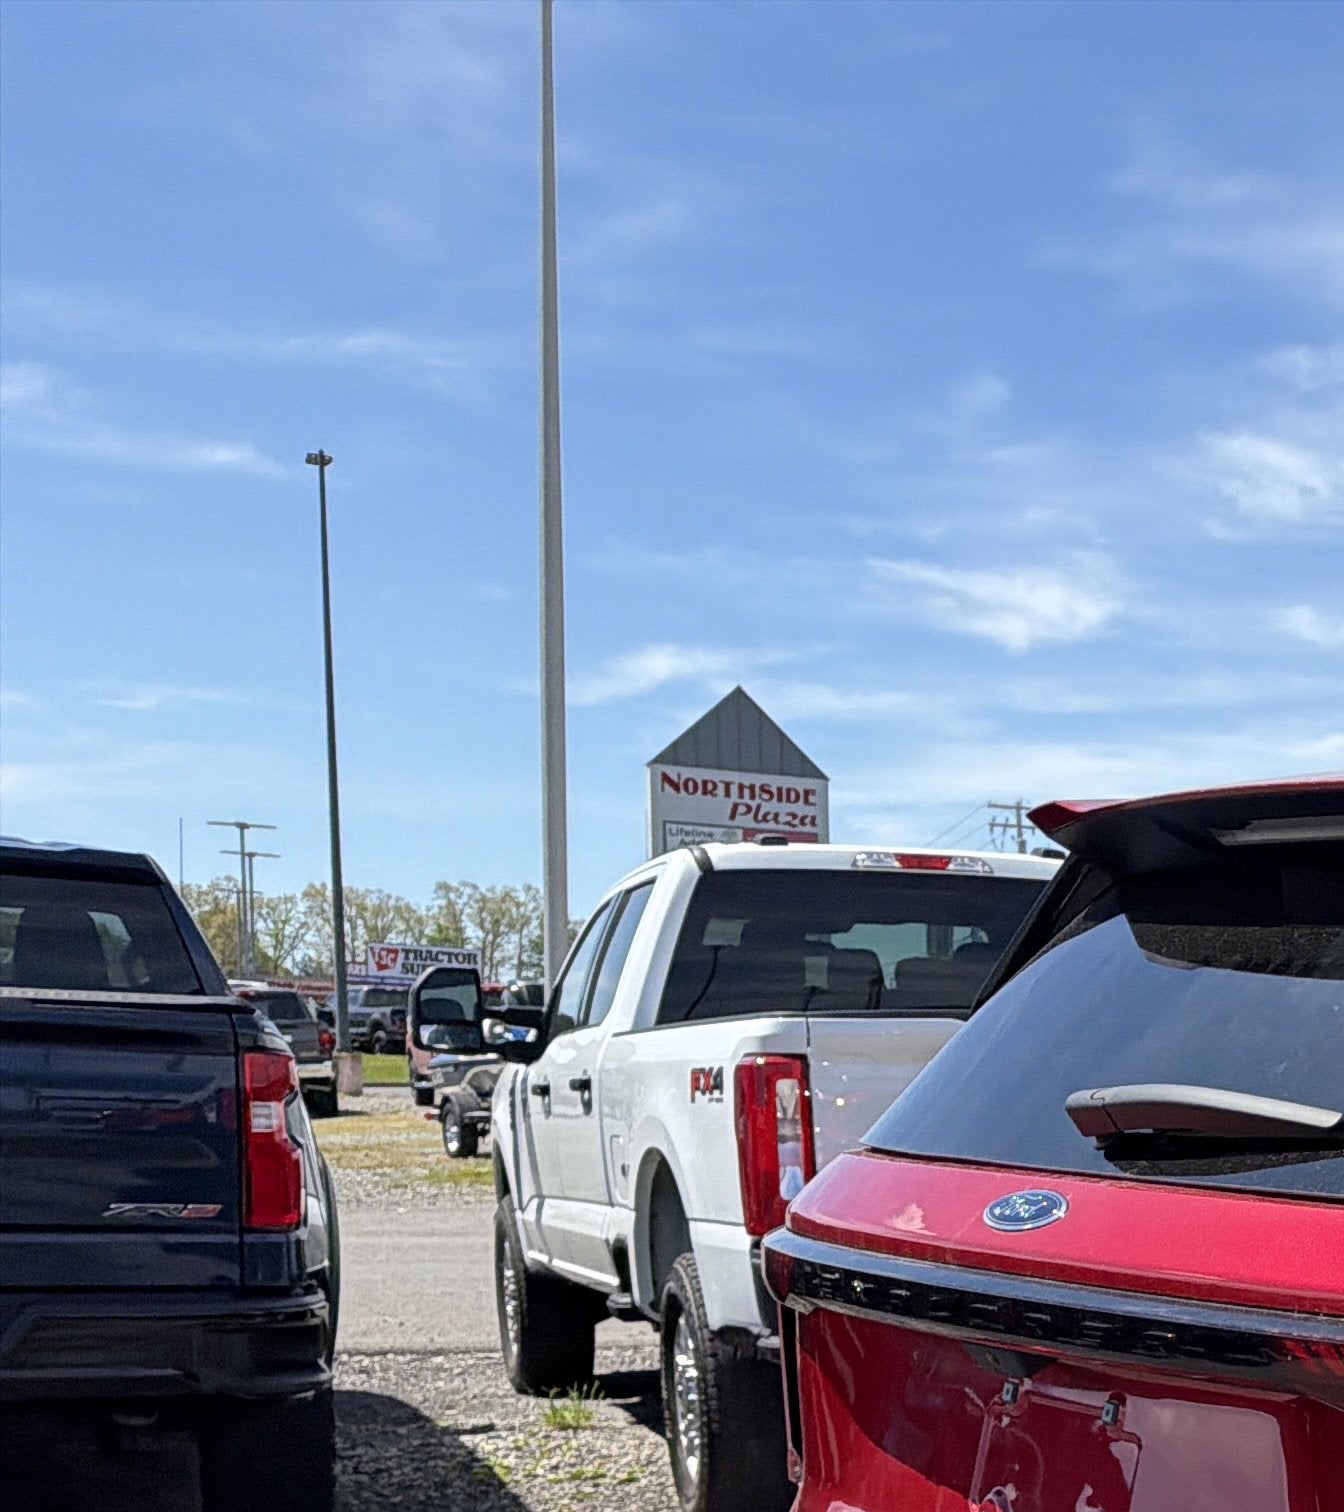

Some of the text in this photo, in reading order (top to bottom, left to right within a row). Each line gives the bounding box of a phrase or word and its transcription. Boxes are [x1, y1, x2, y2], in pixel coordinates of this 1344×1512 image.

[661, 770, 817, 806] NORTHSIDE
[729, 802, 818, 828] Plaza
[401, 948, 478, 965] TRACTOR
[691, 1066, 724, 1104] FX4
